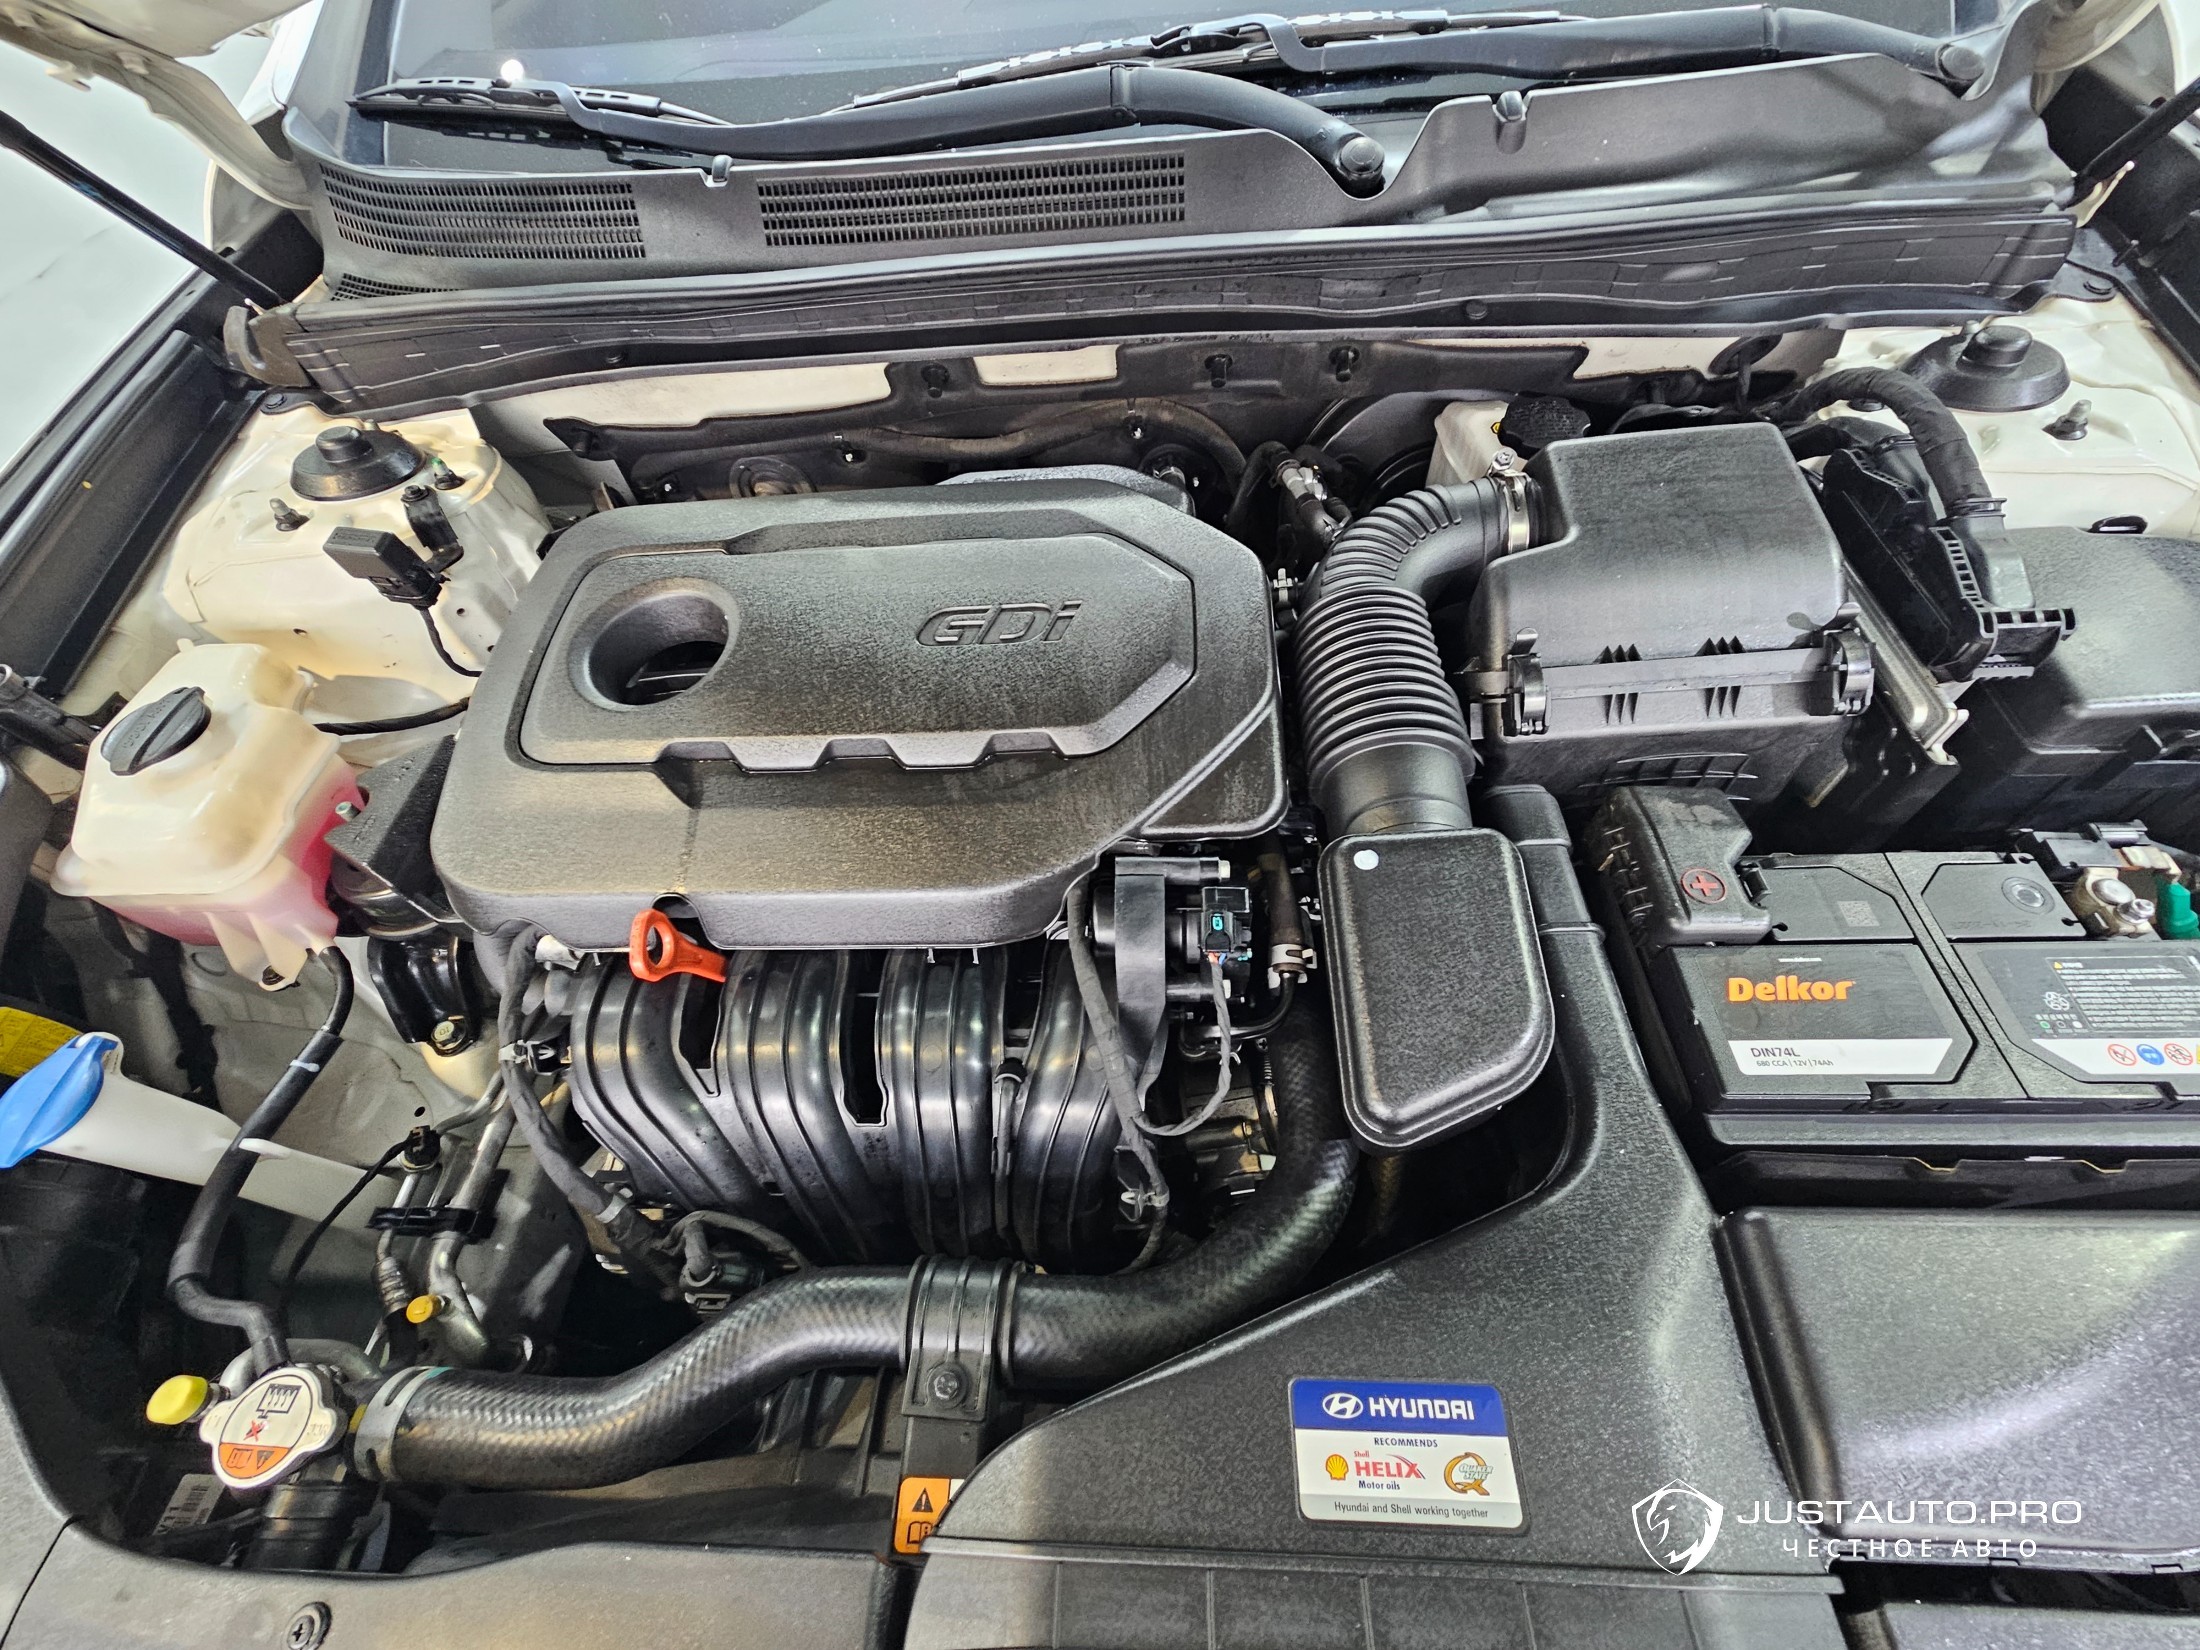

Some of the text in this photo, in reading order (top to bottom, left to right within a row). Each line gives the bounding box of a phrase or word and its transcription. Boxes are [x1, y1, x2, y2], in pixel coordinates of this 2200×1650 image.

[1728, 975, 1853, 1001] Delkor
[1750, 1047, 1801, 1058] DIN74L
[1368, 1396, 1475, 1420] HYUNDAI
[1374, 1437, 1438, 1447] RECOMMENDS
[1353, 1450, 1370, 1458] Shell
[1354, 1460, 1422, 1479] HELIX
[1358, 1480, 1401, 1490] Motor oils
[1334, 1501, 1489, 1519] Hyundai and Shell working together
